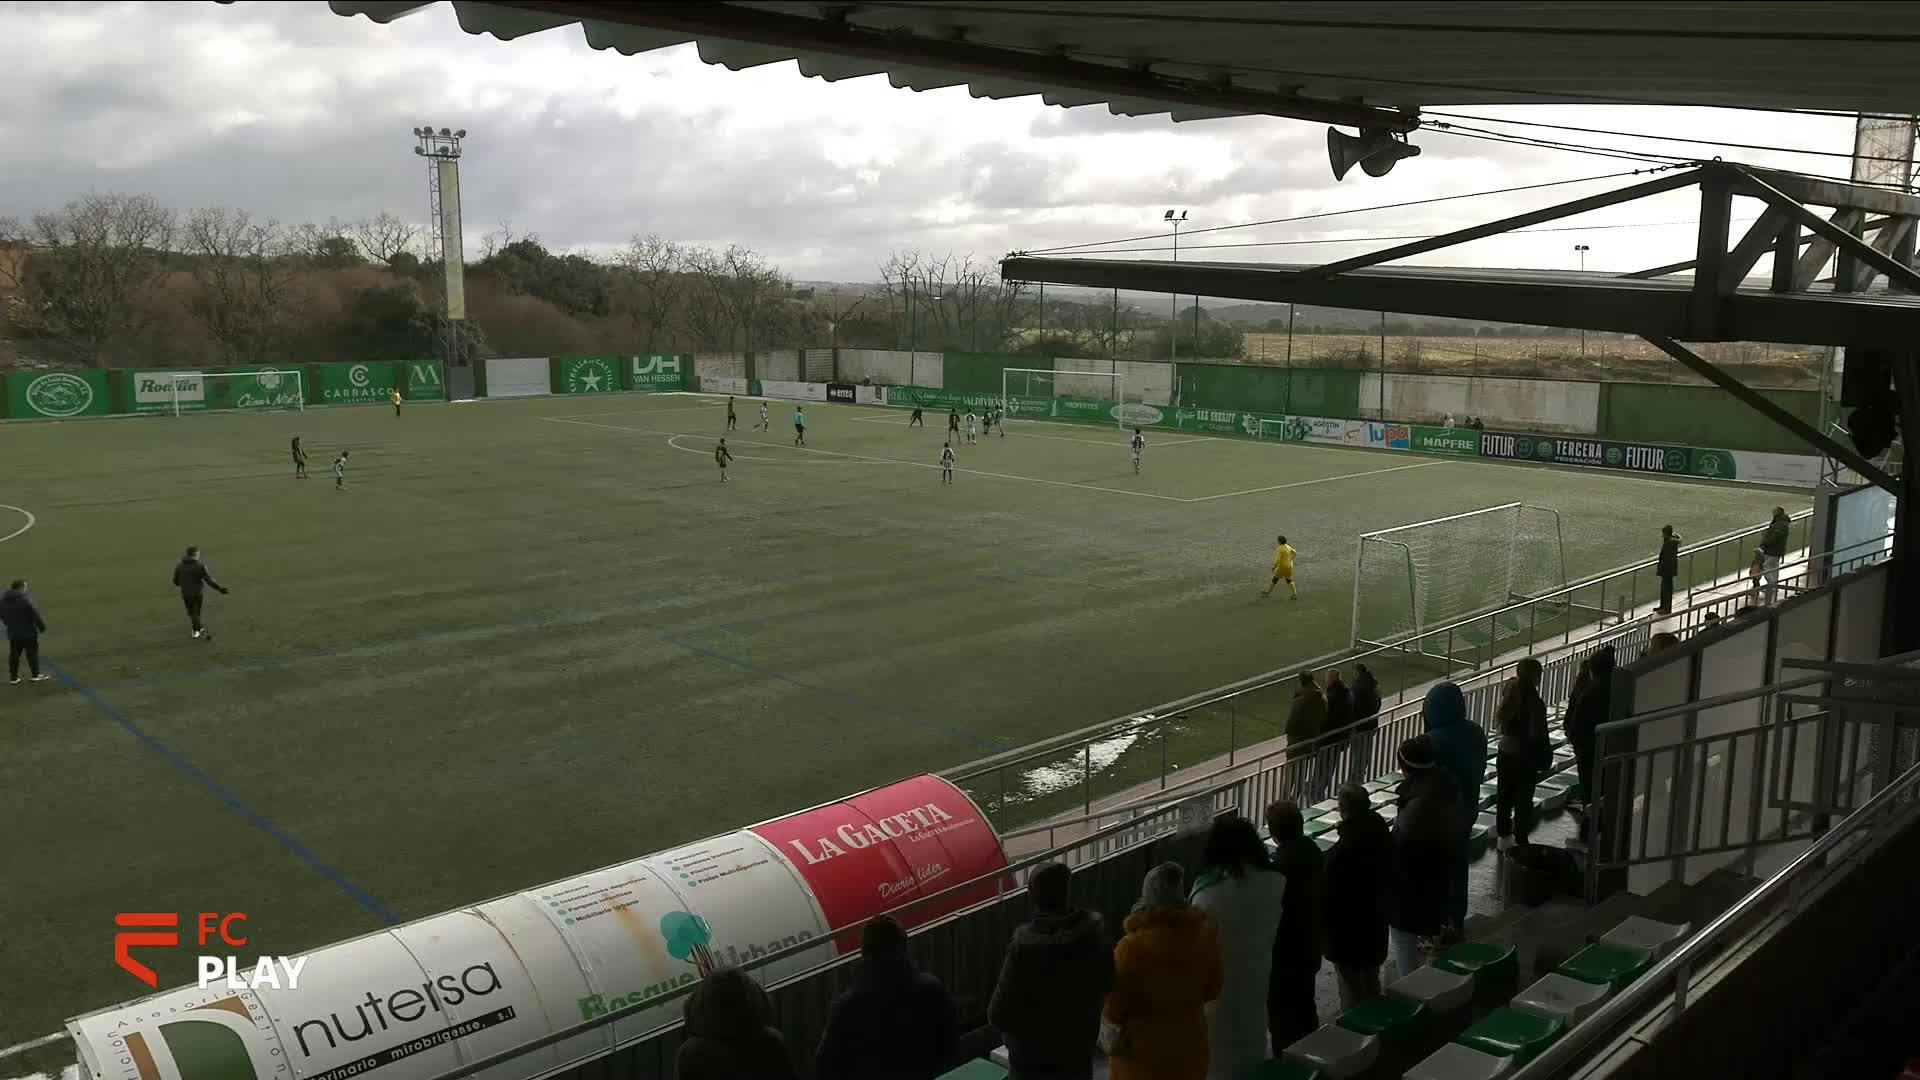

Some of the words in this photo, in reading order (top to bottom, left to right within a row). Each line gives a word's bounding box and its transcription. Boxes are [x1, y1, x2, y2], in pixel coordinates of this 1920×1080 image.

[633, 375, 650, 384] VAN
[651, 374, 681, 383] HESSEN
[323, 387, 394, 398] CARRASCO
[1423, 437, 1474, 450] MAPFRE
[1555, 440, 1602, 459] TERCERA
[788, 837, 847, 865] LA
[836, 803, 953, 849] GACETA
[293, 961, 503, 1057] nutersa
